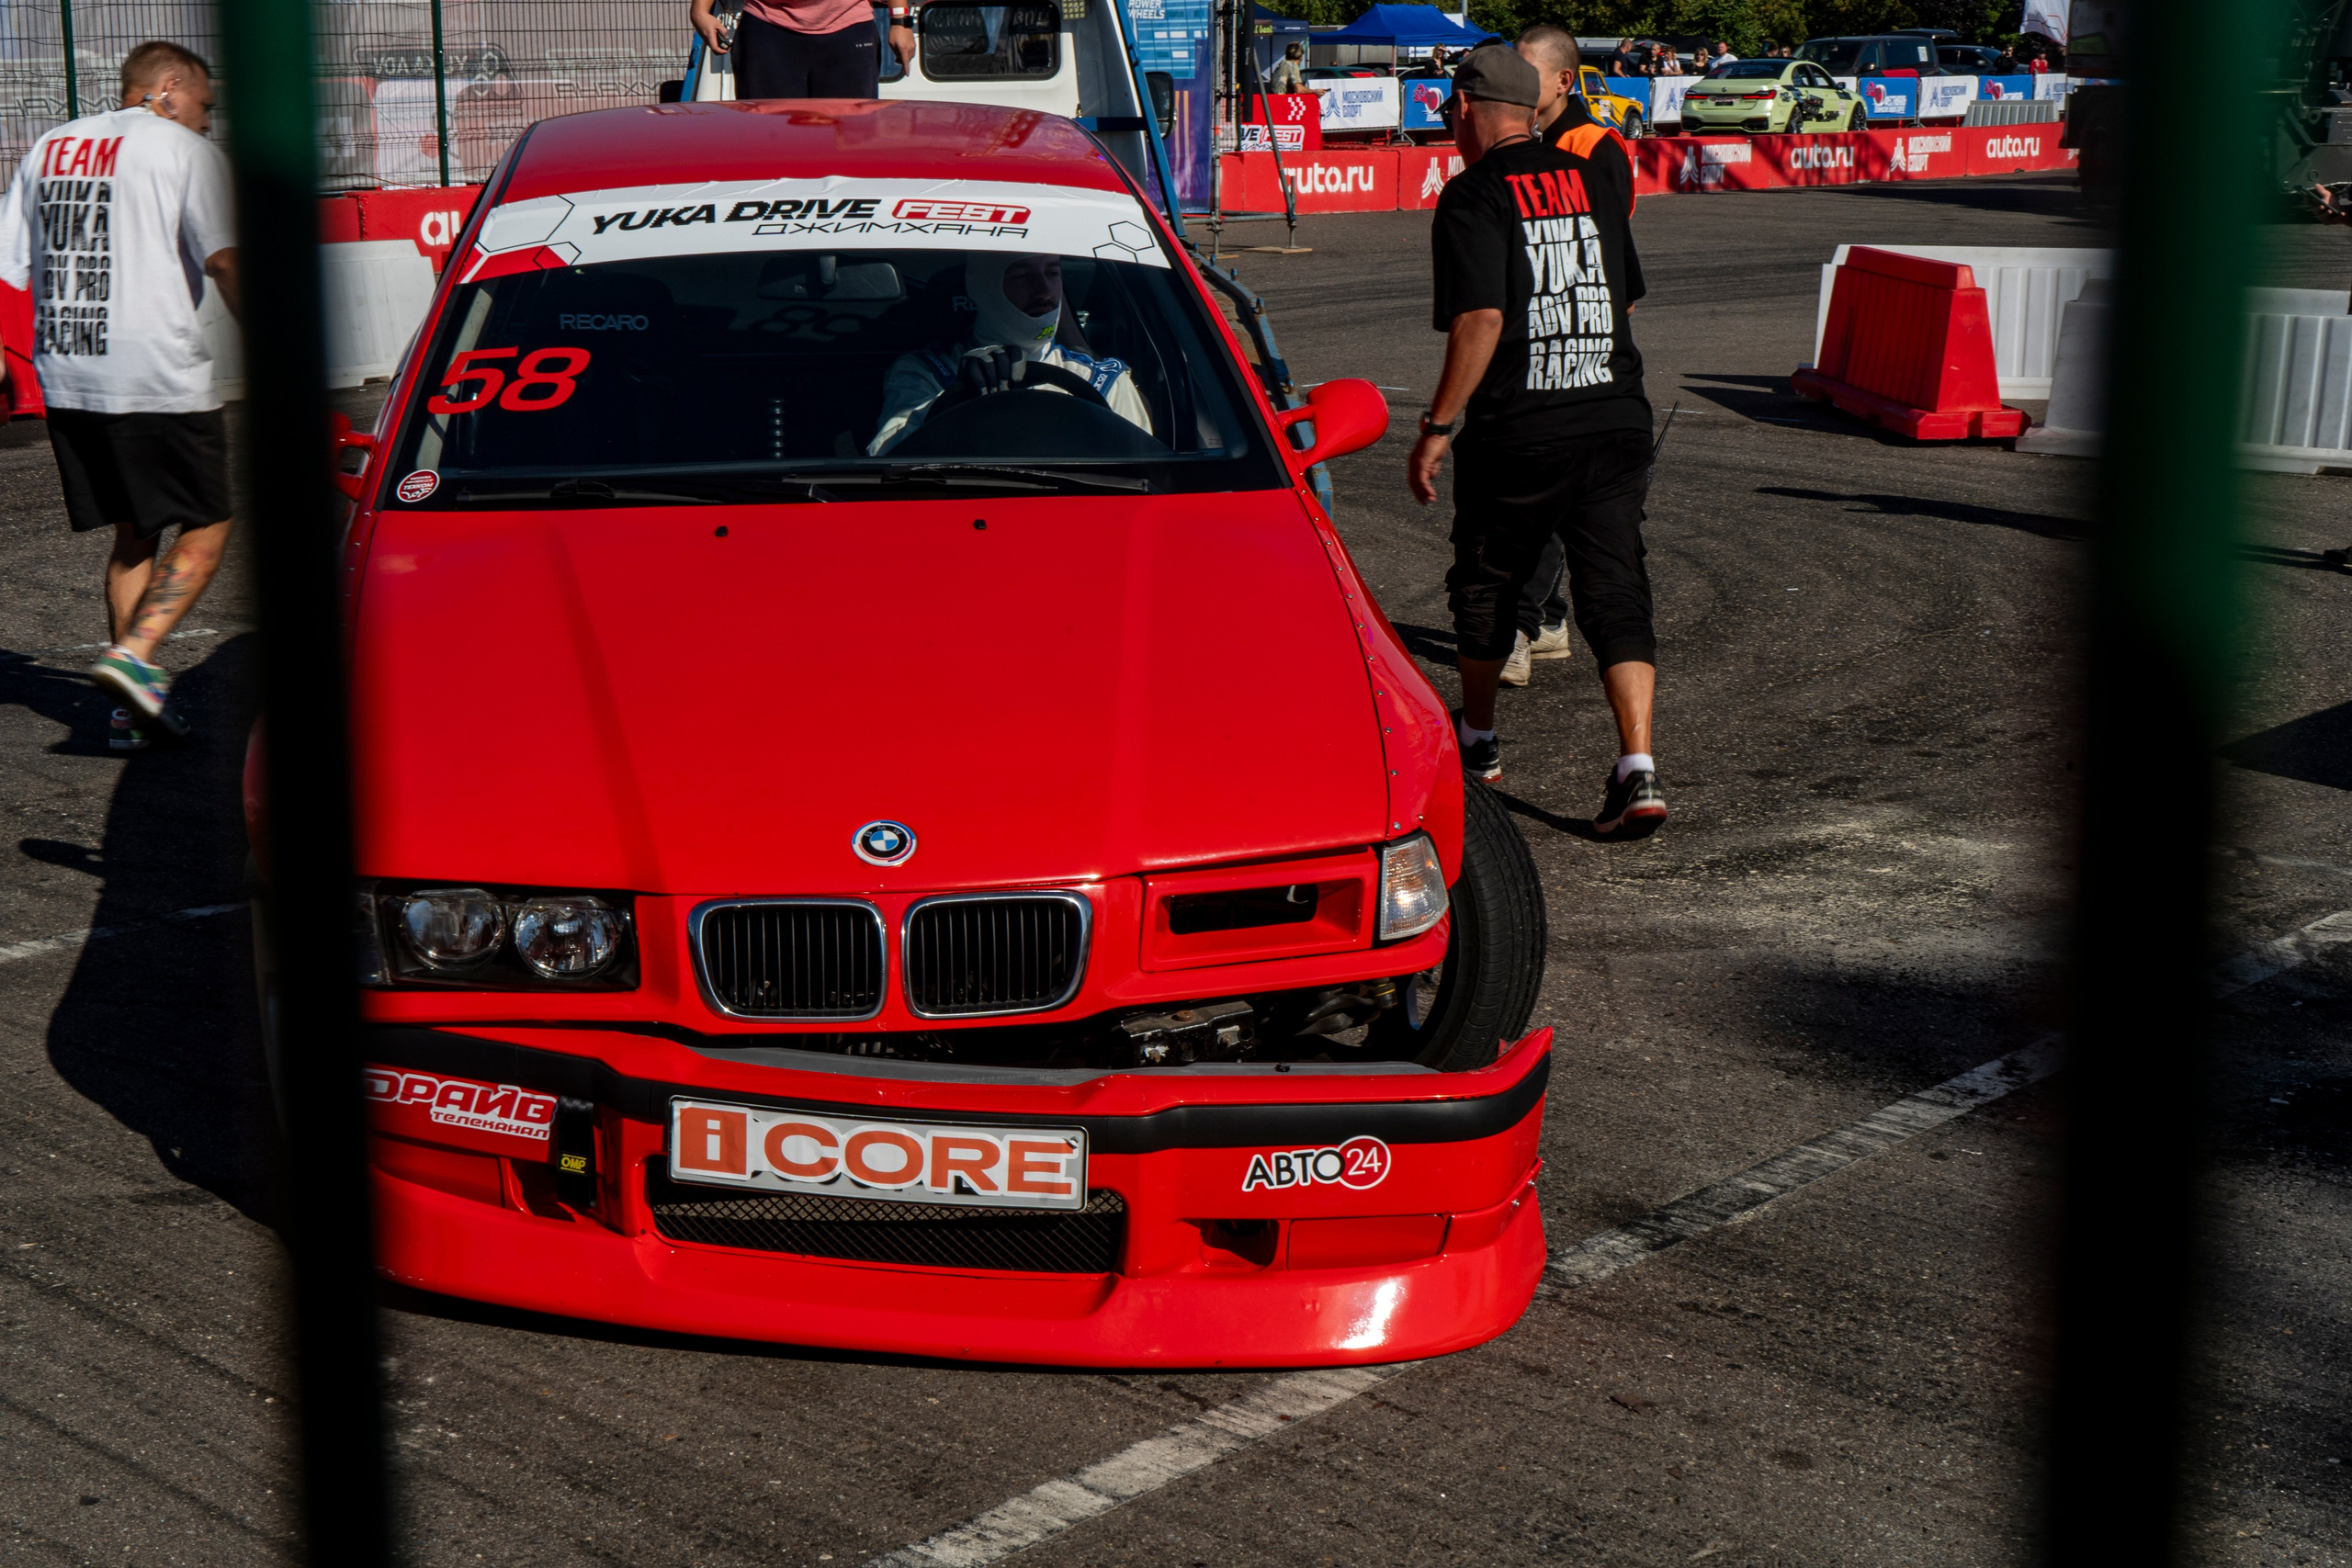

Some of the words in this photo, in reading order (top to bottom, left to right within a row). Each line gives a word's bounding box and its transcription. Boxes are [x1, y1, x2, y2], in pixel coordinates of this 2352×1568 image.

[1127, 9, 1166, 19] WHEELS
[41, 136, 124, 177] TEAM
[1792, 143, 1854, 169] auto.ru
[1986, 135, 2040, 159] auto.ru
[1505, 169, 1590, 219] TEAM
[39, 203, 110, 252] YUKA
[593, 203, 717, 236] YUKA
[723, 197, 882, 222] DRIVE
[898, 200, 1028, 223] FEST
[752, 221, 1029, 239] ДЖИМХАНА
[1525, 236, 1606, 294] YUKA
[74, 271, 110, 302] PRO
[560, 313, 650, 331] RECARO
[1528, 302, 1571, 340] ADV
[1577, 301, 1612, 334] PRO
[427, 345, 591, 414] 58
[1526, 352, 1613, 390] RACING
[560, 1156, 586, 1171] OMP
[763, 1121, 1074, 1196] CORE
